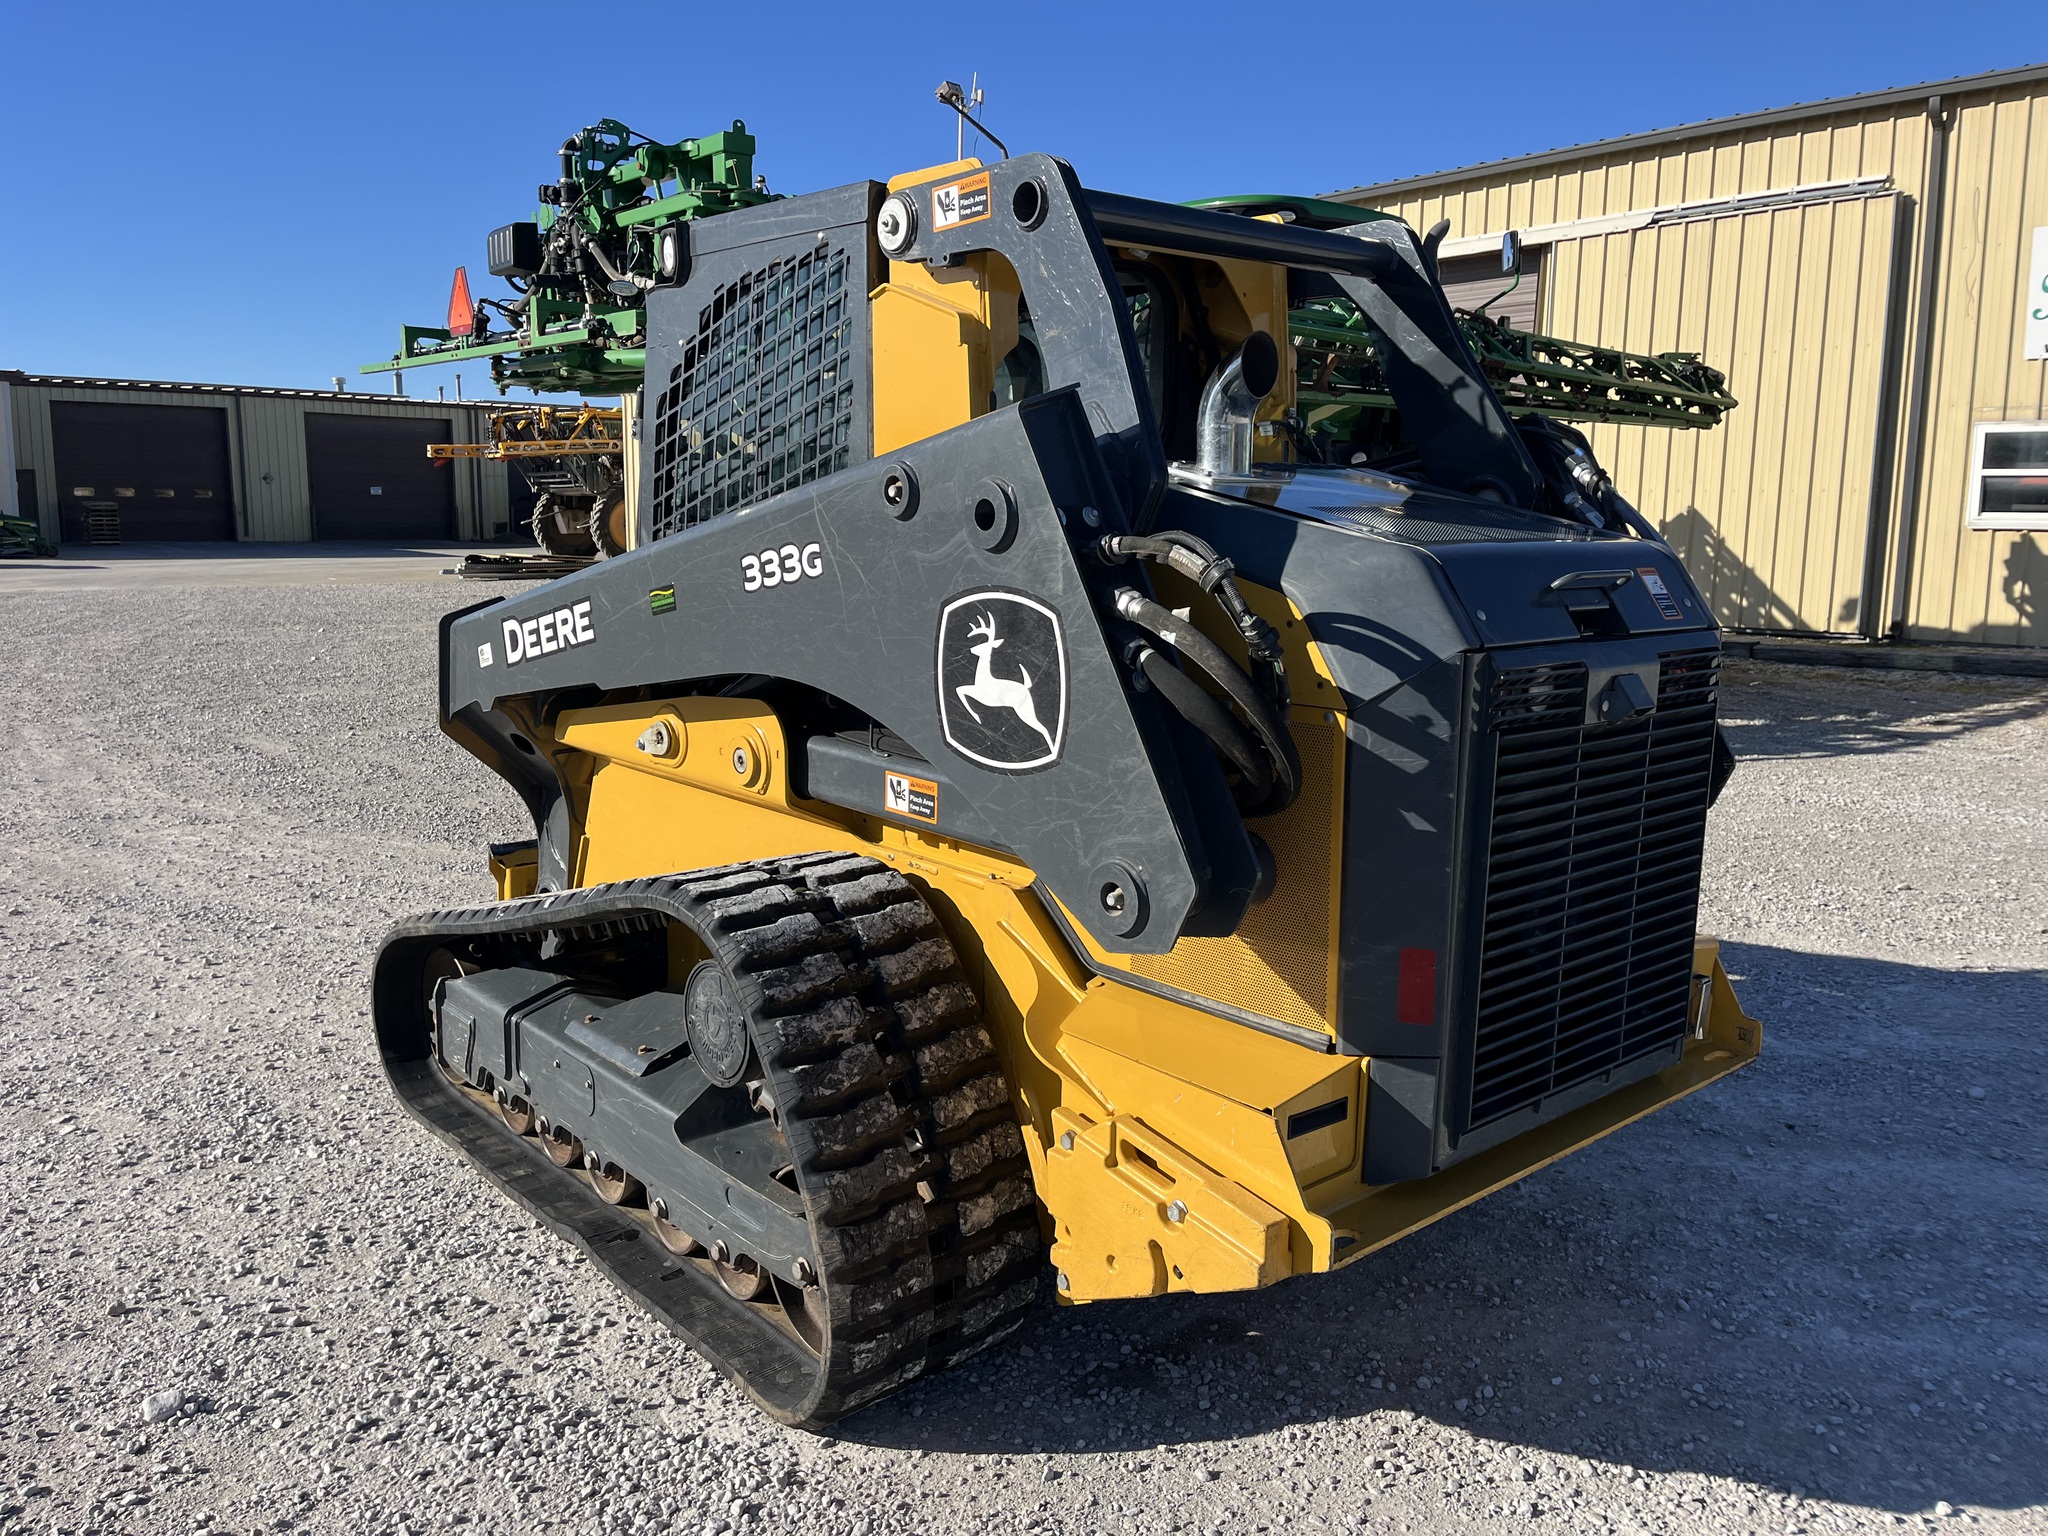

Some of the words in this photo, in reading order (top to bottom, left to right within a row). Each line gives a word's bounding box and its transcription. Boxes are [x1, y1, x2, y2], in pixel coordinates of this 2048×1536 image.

[960, 197, 974, 206] Pinch
[974, 194, 987, 203] Area
[741, 543, 823, 591] 333G
[502, 600, 595, 664] DEERE
[910, 794, 923, 804] Pinch
[922, 798, 934, 807] Area
